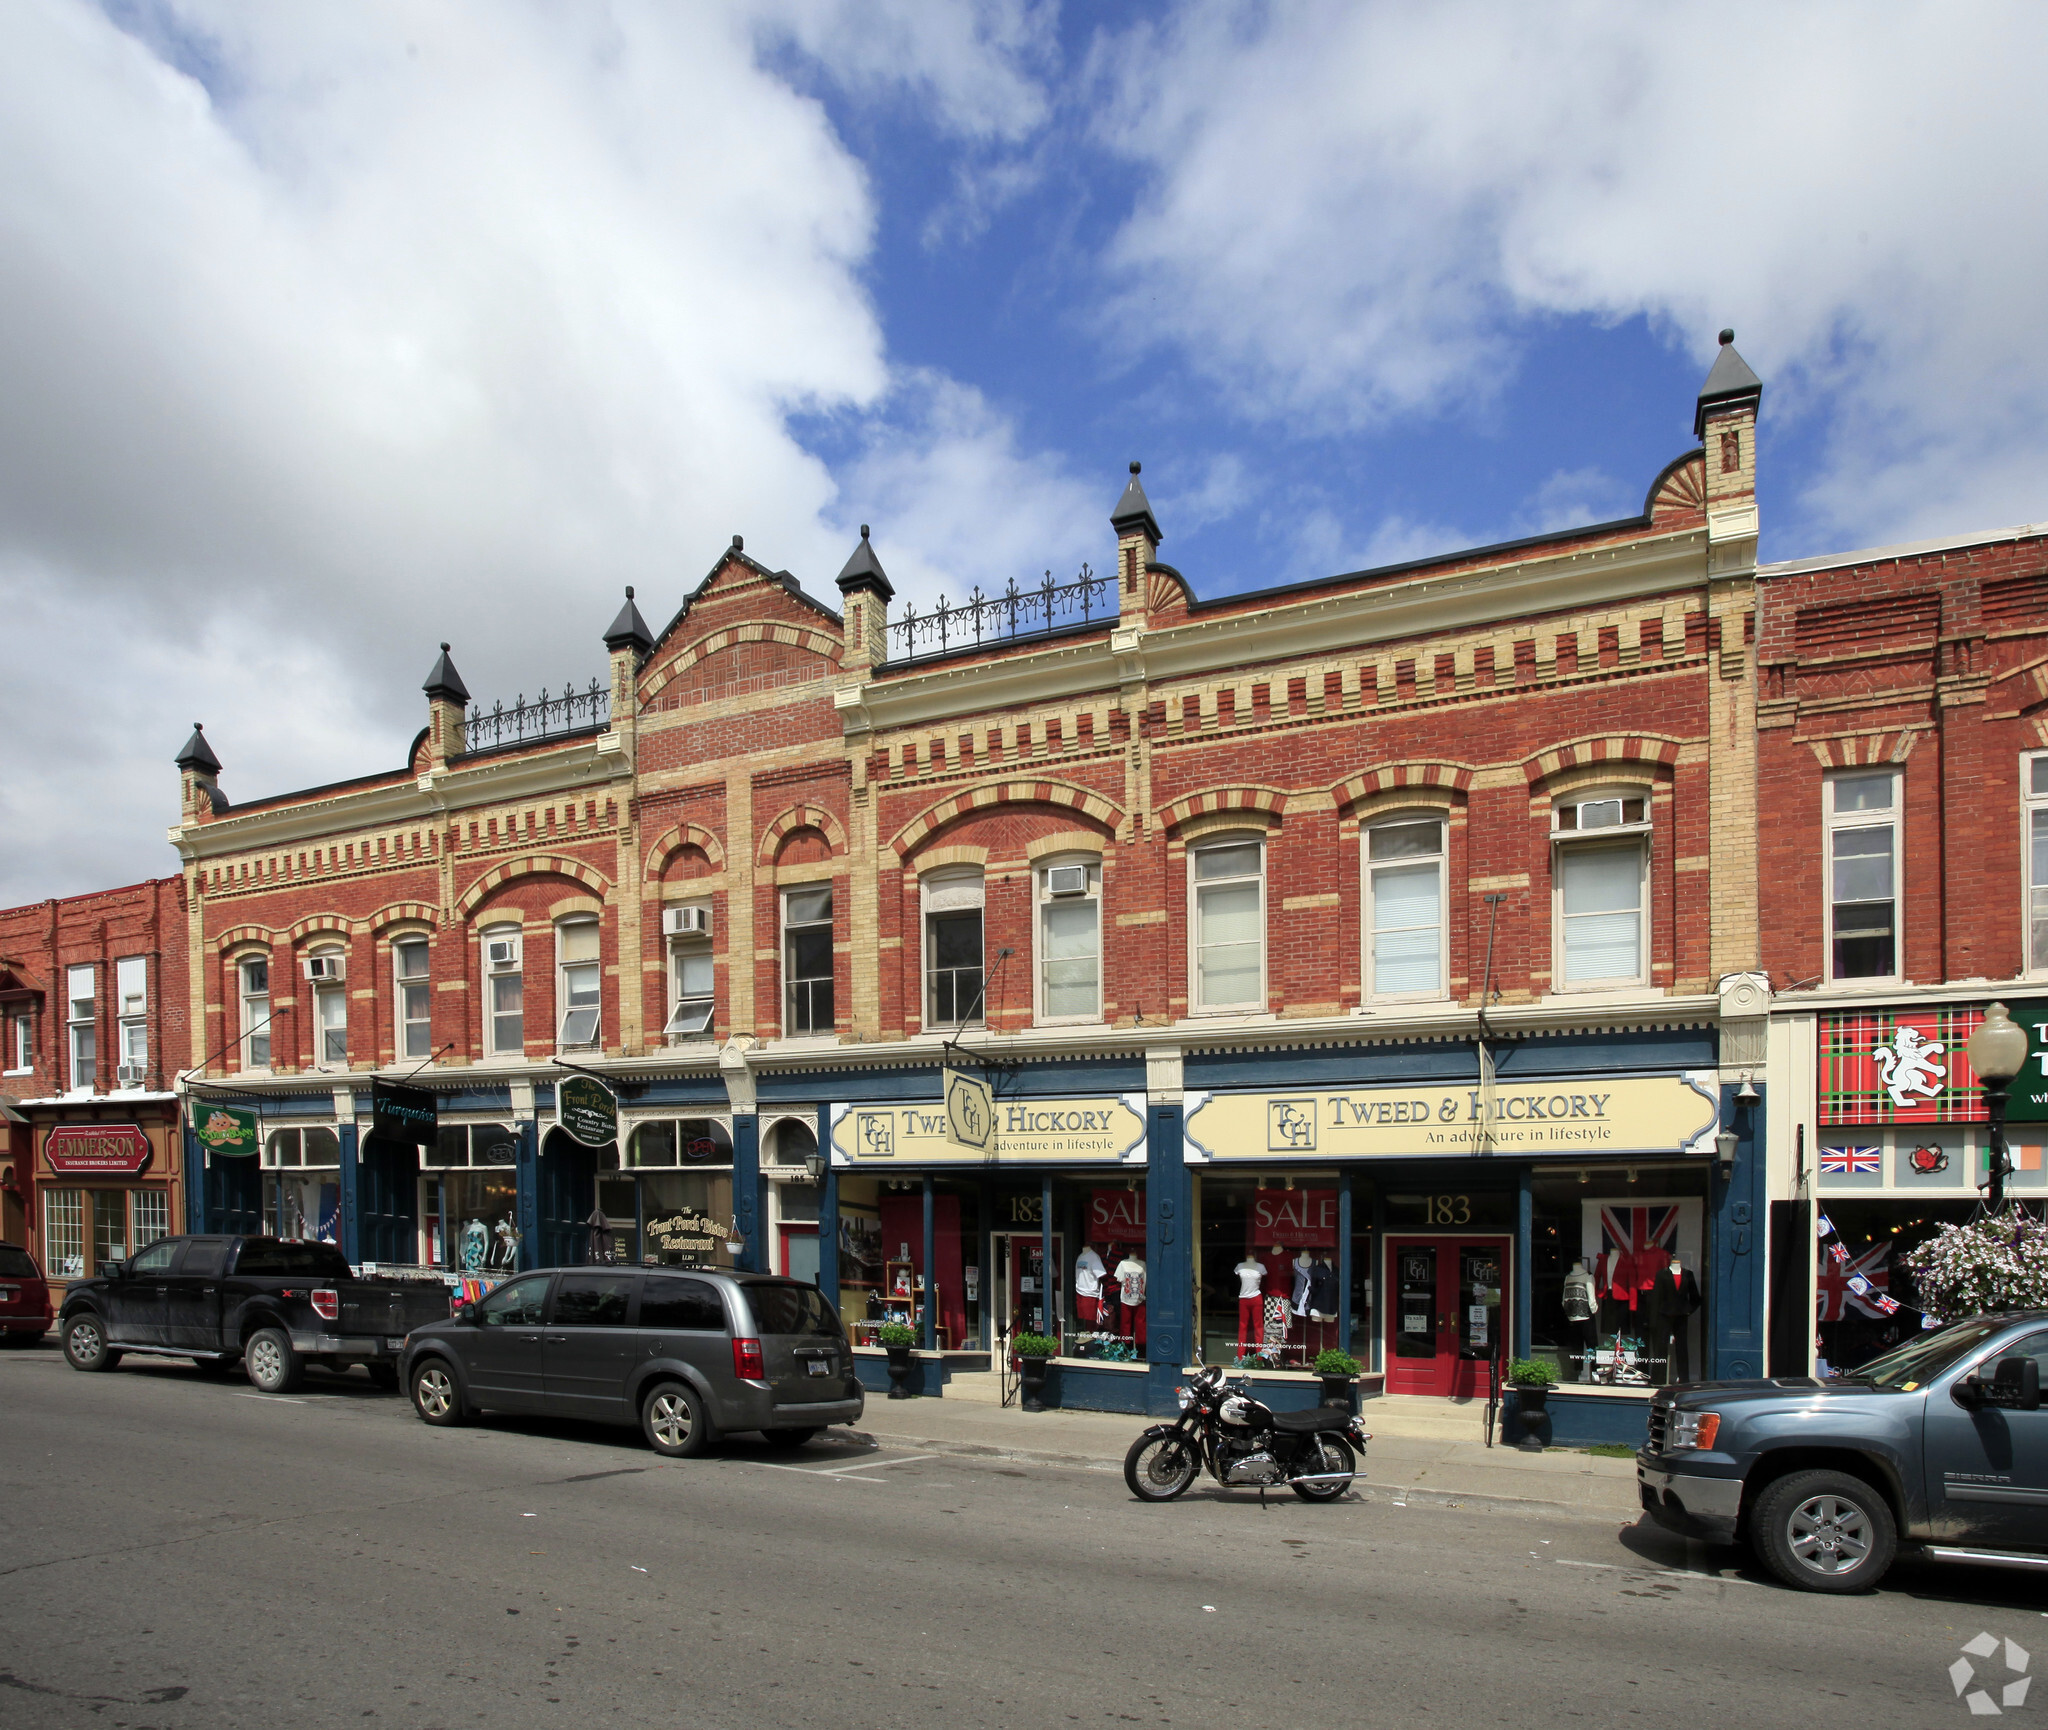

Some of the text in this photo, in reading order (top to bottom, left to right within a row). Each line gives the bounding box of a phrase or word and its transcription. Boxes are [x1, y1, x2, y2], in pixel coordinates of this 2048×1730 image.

[581, 1080, 596, 1091] The
[377, 1097, 436, 1127] Turquoise
[563, 1091, 616, 1117] Front Porch
[1328, 1097, 1430, 1125] TWEED
[1438, 1097, 1459, 1123] &
[564, 1112, 617, 1131] Fine Country Bistro
[576, 1122, 605, 1134] Restaurant
[901, 1110, 946, 1134] TWE
[1006, 1106, 1113, 1132] HICKORY
[1425, 1126, 1611, 1143] An advenure in lifestyle
[58, 1137, 135, 1158] EMMERSON
[489, 1147, 513, 1161] OPEN
[687, 1140, 716, 1153] OPEN
[993, 1138, 1113, 1152] adventure in lifestyle
[790, 1175, 805, 1183] 185
[681, 1206, 692, 1214] The
[1010, 1196, 1043, 1222] 183
[1092, 1190, 1146, 1225] SAL
[1255, 1189, 1336, 1228] SALE
[1424, 1194, 1471, 1225] 183
[646, 1214, 729, 1238] Front Porch Bistro
[660, 1234, 715, 1251] Restaurant
[1943, 1472, 2011, 1483] SIERRA
